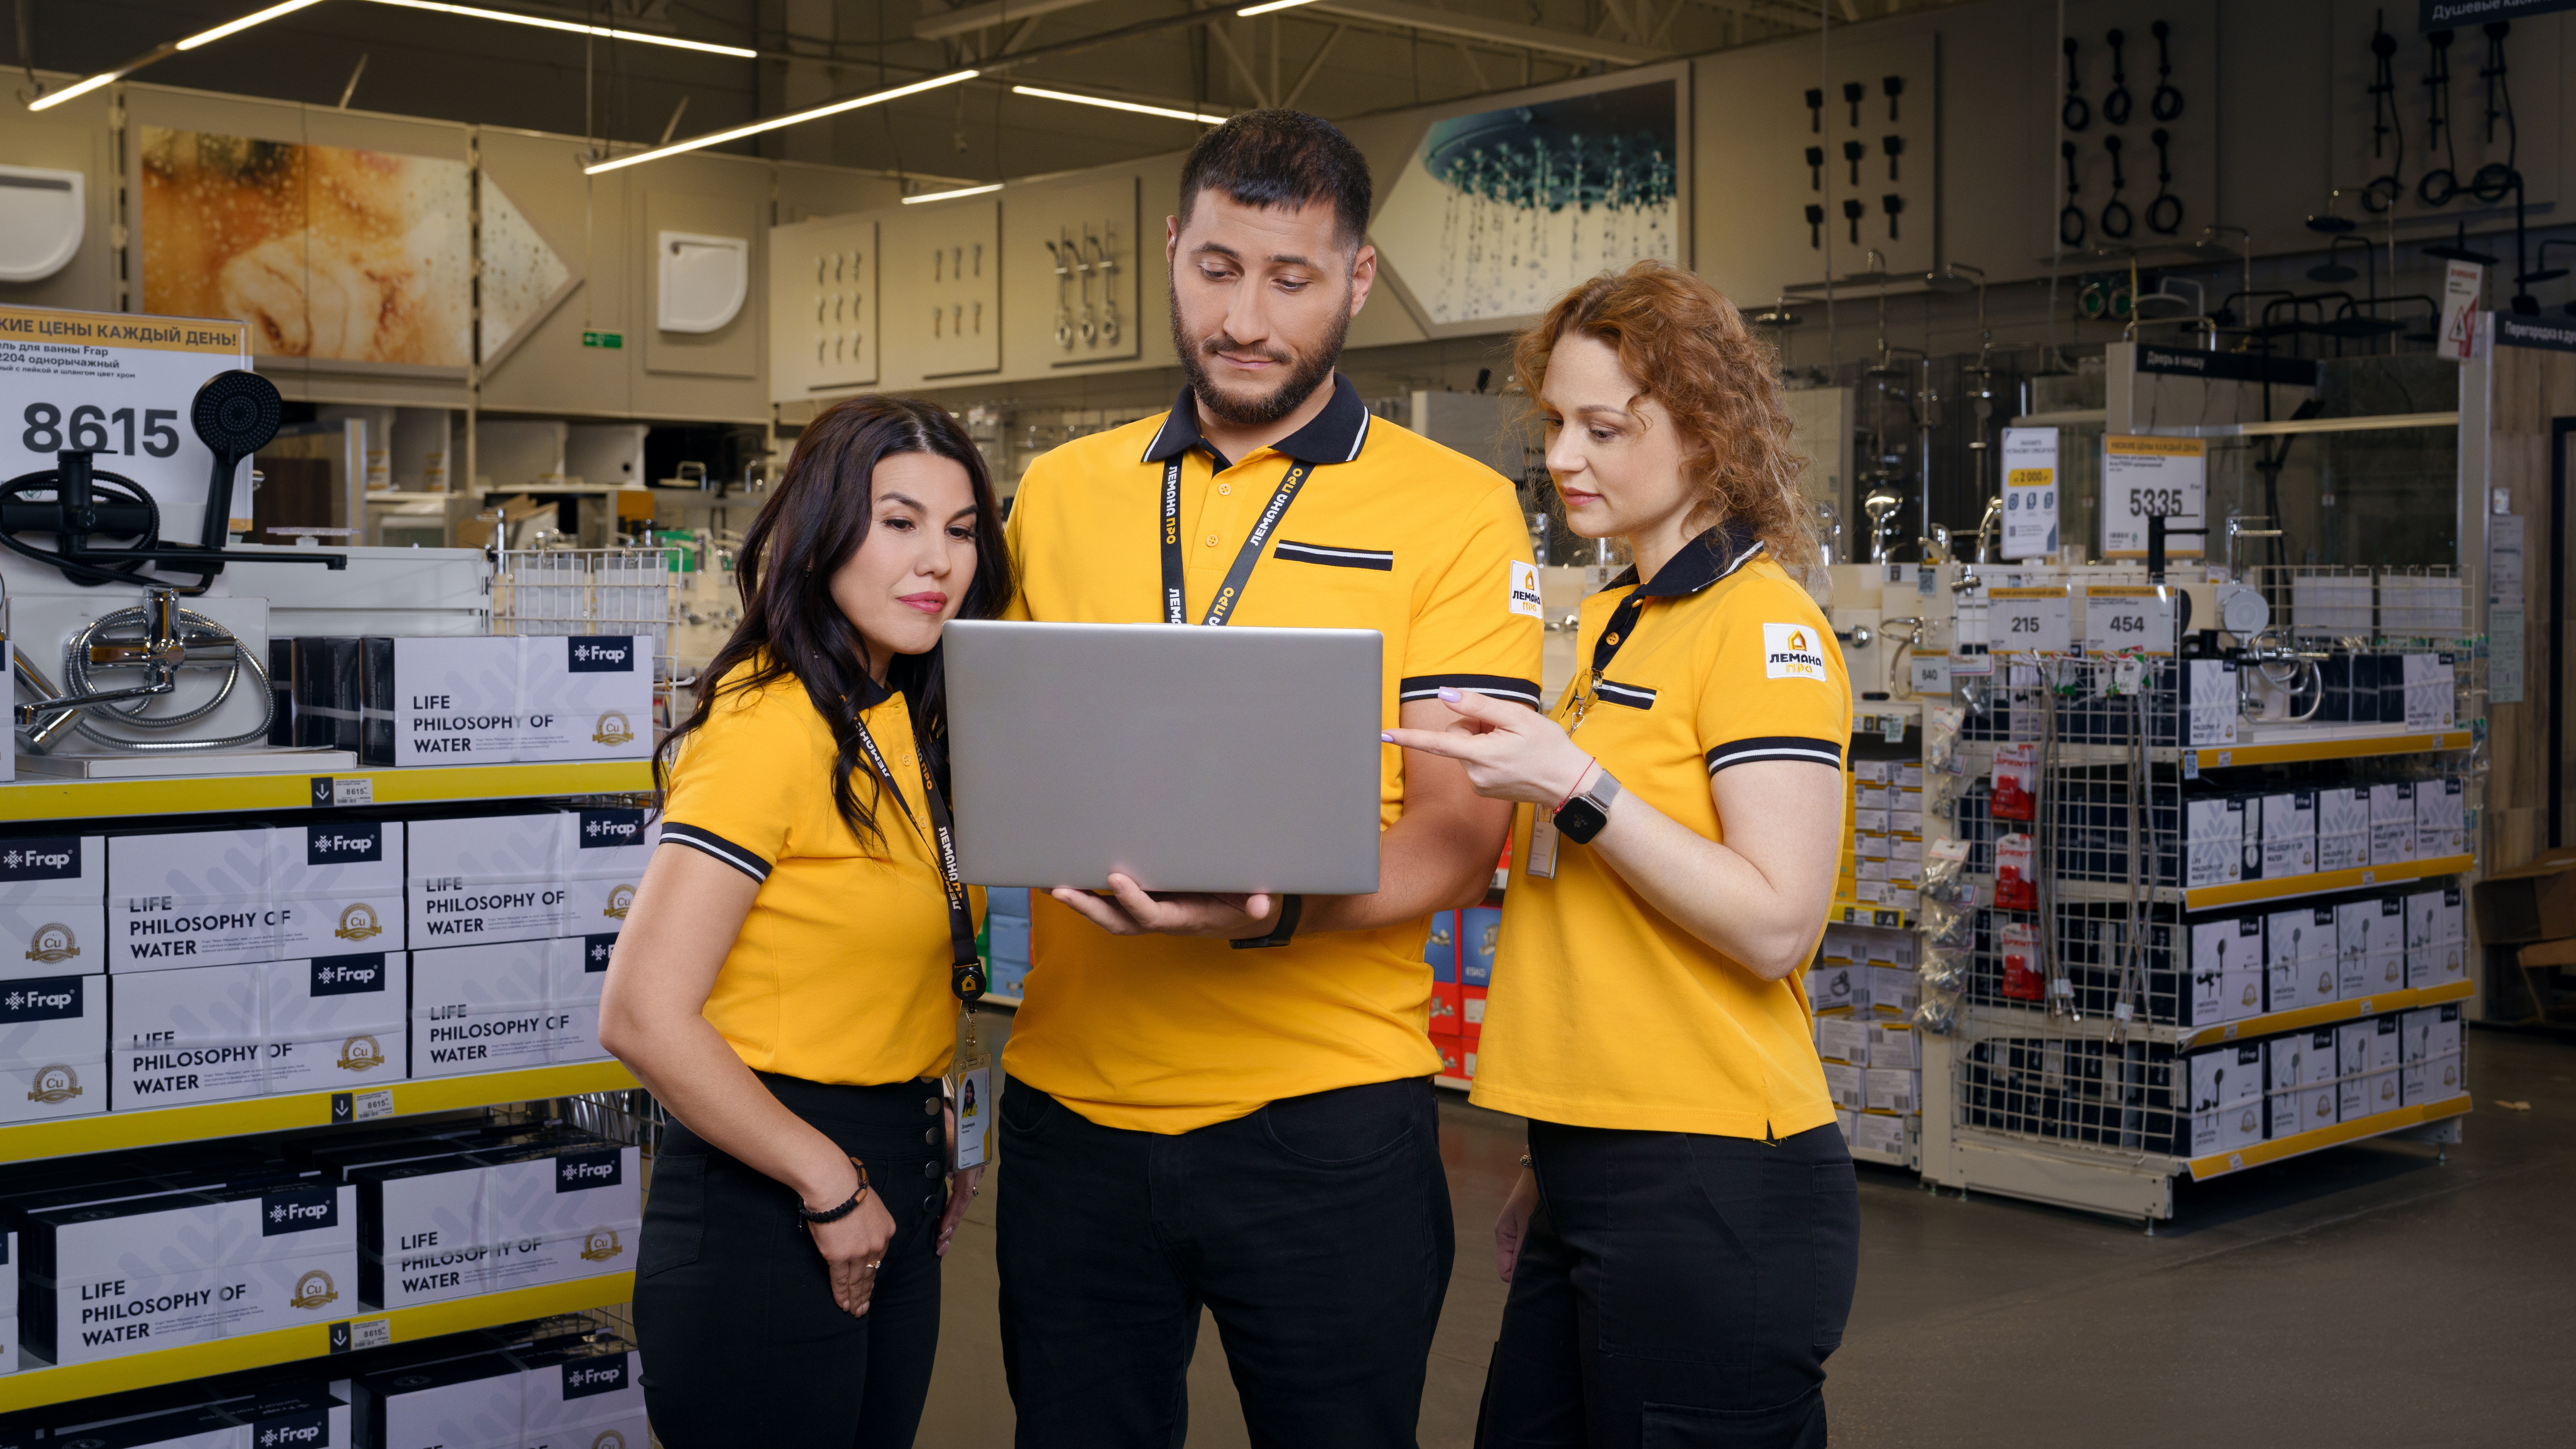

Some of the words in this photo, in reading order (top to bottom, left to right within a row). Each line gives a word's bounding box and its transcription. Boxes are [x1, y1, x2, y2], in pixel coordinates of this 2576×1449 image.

[39, 320, 91, 336] ЦЕНЫ
[97, 323, 181, 343] КАЖДЫЙ
[185, 330, 237, 346] ДЕНЬ!
[19, 343, 40, 351] для
[44, 345, 80, 354] ванны
[84, 346, 108, 357] Frap
[22, 365, 51, 374] лейкой
[29, 356, 119, 368] однорычажный
[22, 402, 179, 458] 8615
[1166, 466, 1177, 516] ЛЕМАНА
[1250, 494, 1288, 546] ЛЕМАНА
[1282, 468, 1303, 493] ПРО
[2130, 488, 2182, 516] 5335
[1166, 517, 1176, 544] ПРО
[1169, 588, 1182, 624] ЛЕМА
[1213, 587, 1234, 616] ПРО
[1512, 590, 1541, 605] ЛЕМАНА
[1523, 602, 1537, 612] ПРО
[2012, 617, 2039, 632] 215
[2110, 616, 2145, 632] 454
[591, 646, 625, 663] Frap
[1769, 653, 1822, 667] ЛЕМАНА
[1786, 664, 1812, 673] ПРО
[414, 696, 450, 709] LIFE
[414, 715, 521, 731] PHILOSOPHY
[530, 715, 553, 728] OF
[606, 724, 619, 732] Cu
[414, 738, 471, 752] WATER
[921, 761, 933, 790] ПРО
[603, 821, 636, 836] Frap
[334, 836, 372, 852] Frap
[26, 851, 69, 869] Frap
[939, 826, 958, 881] ЛЕМАНА
[426, 877, 462, 892] LIFE
[130, 896, 172, 912] LIFE
[427, 893, 535, 913] PHILOSOPHY
[542, 891, 565, 904] OF
[131, 913, 256, 936] PHILOSOPHY
[264, 910, 290, 925] OF
[351, 917, 365, 926] Cu
[427, 918, 483, 935] WATER
[44, 938, 61, 948] Cu
[131, 940, 196, 958] WATER
[337, 968, 375, 983] Frap
[28, 992, 71, 1009] Frap
[431, 1004, 467, 1021] LIFE
[431, 1017, 539, 1042] PHILOSOPHY
[546, 1015, 569, 1029] OF
[134, 1031, 174, 1049] LIFE
[134, 1045, 258, 1072] PHILOSOPHY
[268, 1043, 293, 1058] OF
[353, 1048, 368, 1057] Cu
[431, 1045, 487, 1063] WATER
[46, 1078, 64, 1088] Cu
[134, 1075, 199, 1094] WATER
[579, 1163, 613, 1178] Frap
[289, 1203, 328, 1219] Frap
[401, 1232, 437, 1250] LIFE
[594, 1239, 608, 1248] Cu
[401, 1240, 512, 1272] PHILOSOPHY
[518, 1237, 542, 1253] OF
[82, 1280, 125, 1300] LIFE
[307, 1285, 321, 1294] Cu
[402, 1272, 460, 1293] WATER
[82, 1289, 211, 1324] PHILOSOPHY
[219, 1284, 246, 1301] OF
[82, 1323, 149, 1346] WATER
[364, 1329, 383, 1337] 8615
[586, 1369, 619, 1383] Frap
[280, 1424, 319, 1443] Frap
